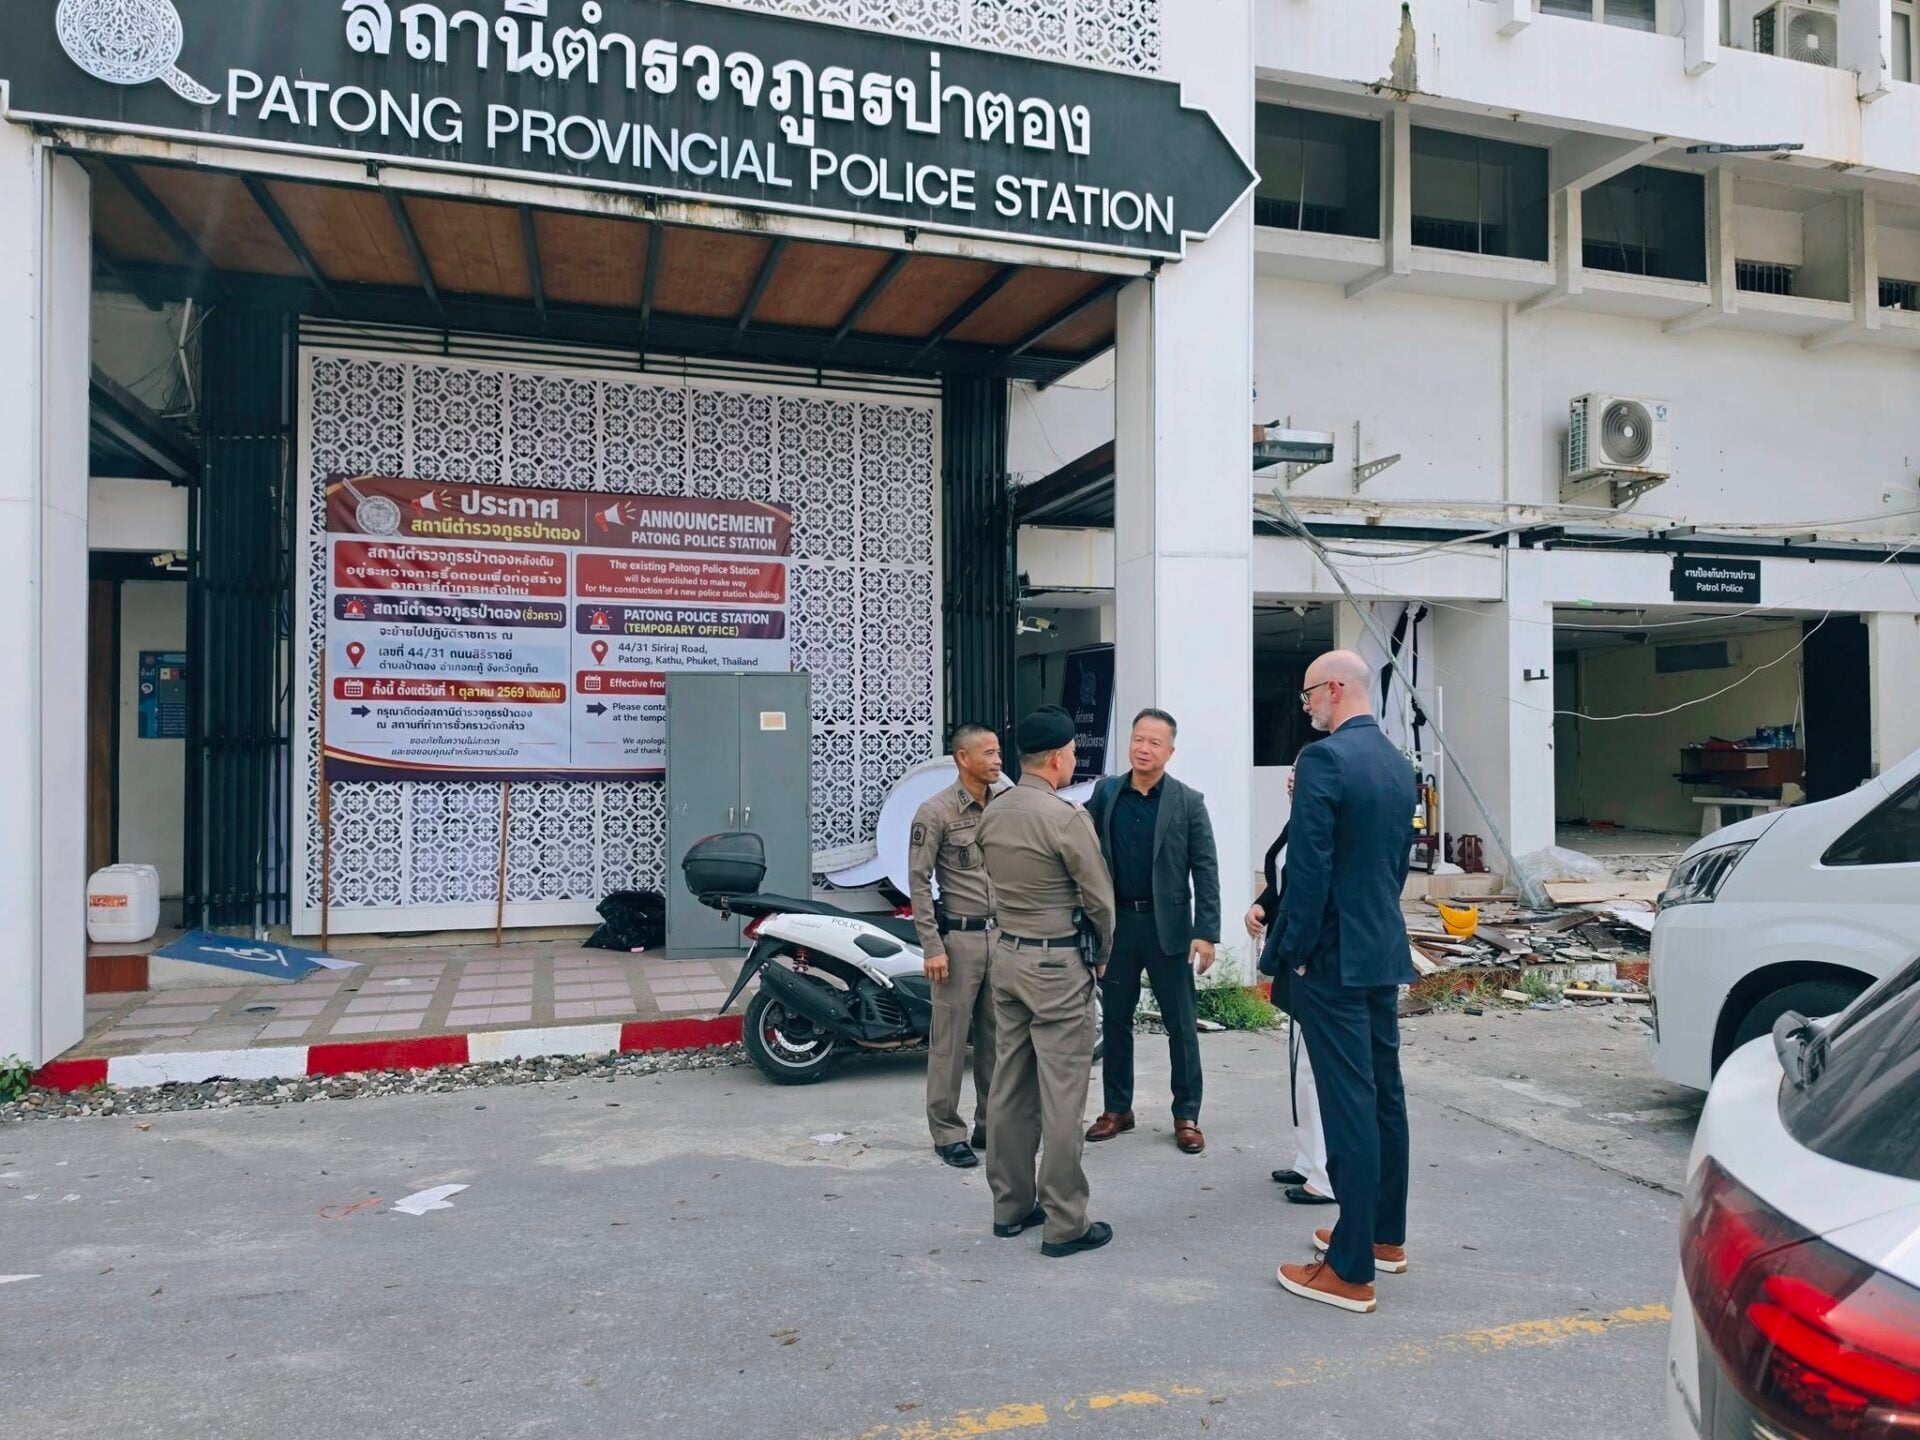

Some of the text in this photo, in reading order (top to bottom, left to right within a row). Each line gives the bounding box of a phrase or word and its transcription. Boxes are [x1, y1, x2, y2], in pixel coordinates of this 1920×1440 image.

[341, 0, 1091, 156] สถานีตำรวจภูธรป่าตอง
[227, 68, 1173, 235] PATONG PROVINCIAL POLICE STATION
[461, 490, 558, 519] ประกาศ
[411, 517, 581, 541] สถานีตำรวจภูธรป่าตอง
[640, 510, 775, 534] ANNOUNCEMENT
[632, 531, 776, 550] PATONG POLICE STATION
[368, 546, 553, 567] สถานีตำรวจภูธรป่าตองหลังเดิม
[610, 559, 760, 575] The existing Patong Police Station
[625, 575, 639, 583] will
[640, 575, 650, 584] be
[653, 576, 697, 585] demolished
[710, 578, 729, 587] make
[732, 580, 747, 588] way
[1697, 582, 1744, 593] Patrol Police
[585, 584, 596, 592] for
[599, 585, 613, 593] the
[614, 586, 663, 595] construction
[698, 589, 720, 599] police
[722, 590, 747, 598] station
[749, 591, 782, 601] building.
[373, 601, 521, 622] สถานีตำรวจภูธรป่าตอง
[624, 609, 769, 625] PATONG POLICE STATION
[502, 631, 512, 640] ณ
[624, 623, 739, 637] (TEMPORARY OFFICE)
[379, 644, 404, 657] เลขที่
[408, 647, 444, 658] 44/31
[619, 643, 707, 655] 44/31 Siriraj Road,
[379, 660, 436, 671] ตำบลป่าตอง
[619, 655, 758, 666] Patong, Kathu, Phuket, Thailand
[373, 681, 394, 696] ทั้งนี้
[449, 686, 455, 696] 1
[459, 686, 493, 700] ตุลาคม
[497, 686, 524, 698] 2569
[610, 679, 647, 688] Effective
[613, 703, 640, 712] Please
[377, 722, 386, 730] ณ
[641, 747, 661, 755] thank
[832, 918, 864, 932] POLICE
